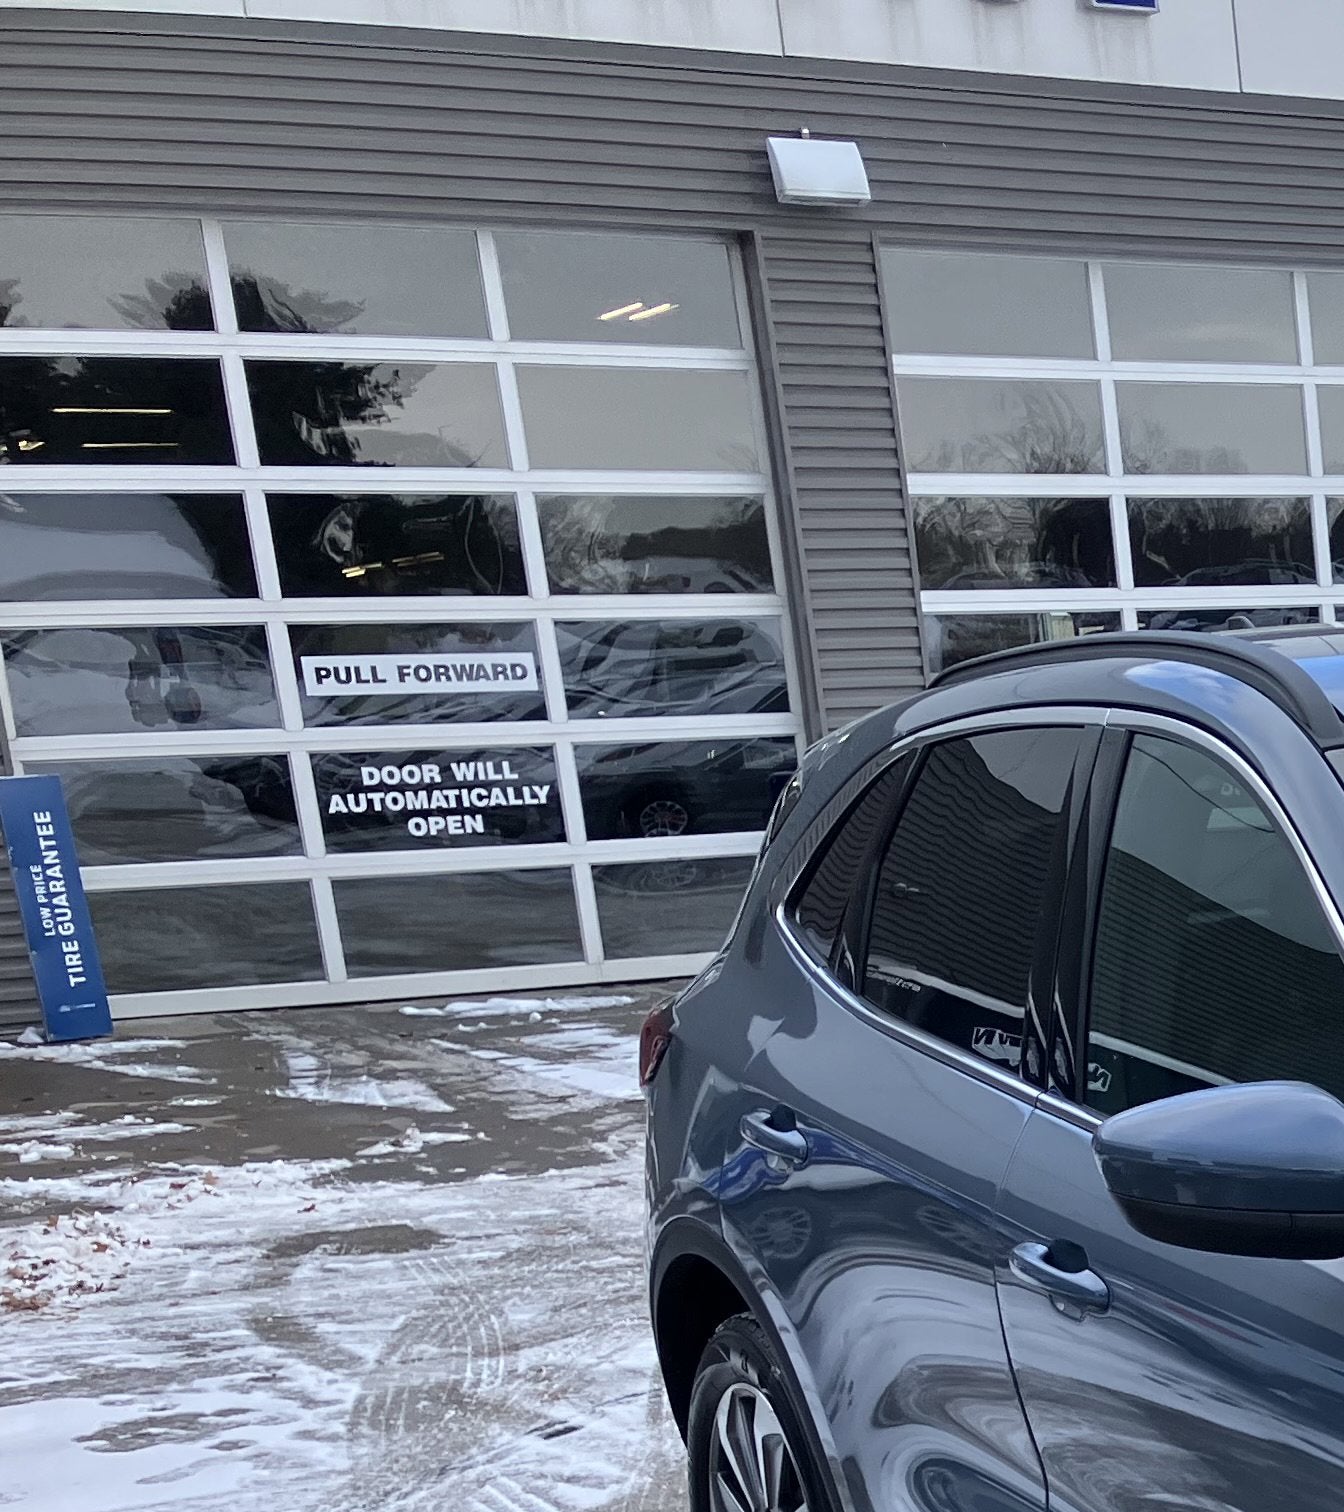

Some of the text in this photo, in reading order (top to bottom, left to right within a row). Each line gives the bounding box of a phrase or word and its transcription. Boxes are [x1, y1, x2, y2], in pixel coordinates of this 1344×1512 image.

[313, 660, 530, 687] PULL FORWARD
[360, 760, 520, 787] DOOR WILL
[328, 784, 551, 815] AUTOMATICALLY
[407, 812, 486, 837] OPEN
[29, 863, 57, 937] LOW PRICE
[32, 810, 87, 988] TIRE GUARANTEE
